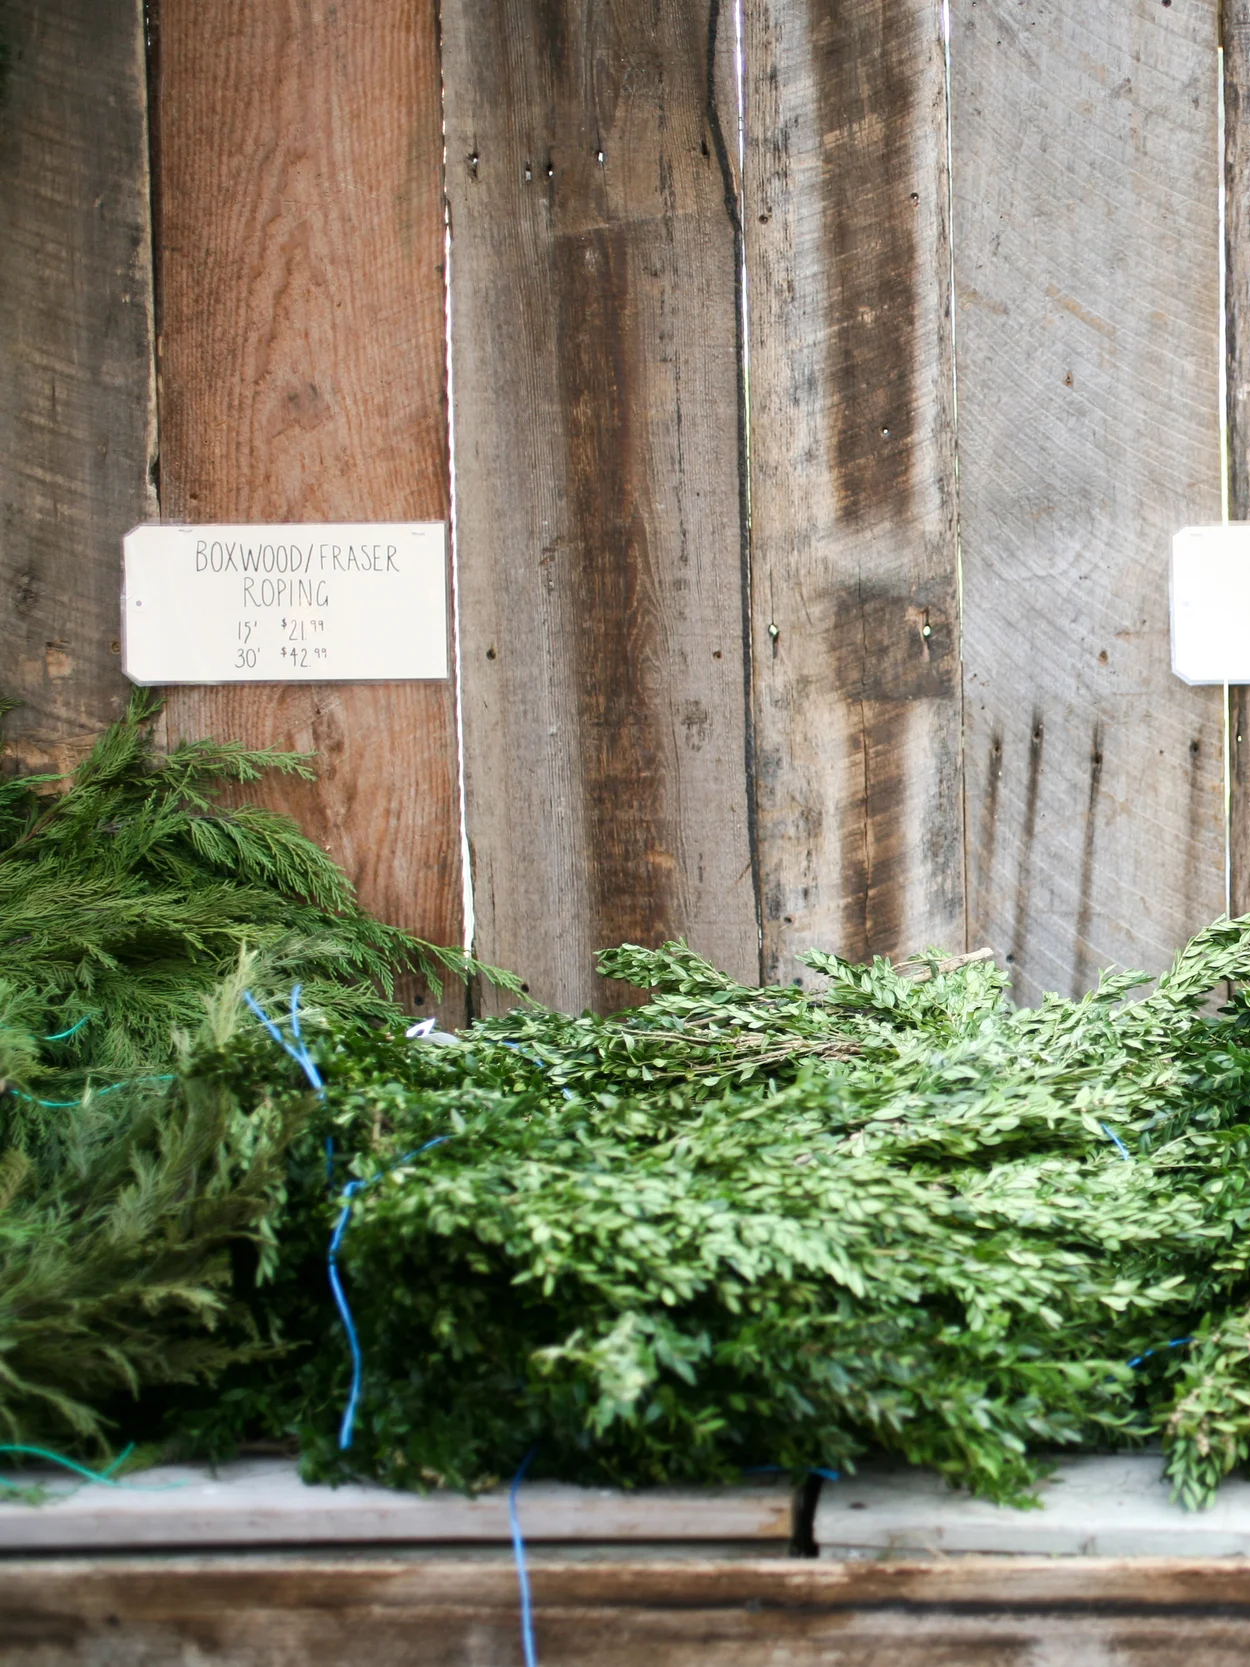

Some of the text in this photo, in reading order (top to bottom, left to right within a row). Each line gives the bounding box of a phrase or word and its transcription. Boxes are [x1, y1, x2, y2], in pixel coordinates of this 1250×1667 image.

[195, 540, 400, 573] BOXWOOD/FRASER
[243, 576, 329, 608] ROPING
[237, 621, 258, 644] 15'
[234, 647, 260, 668] 30'
